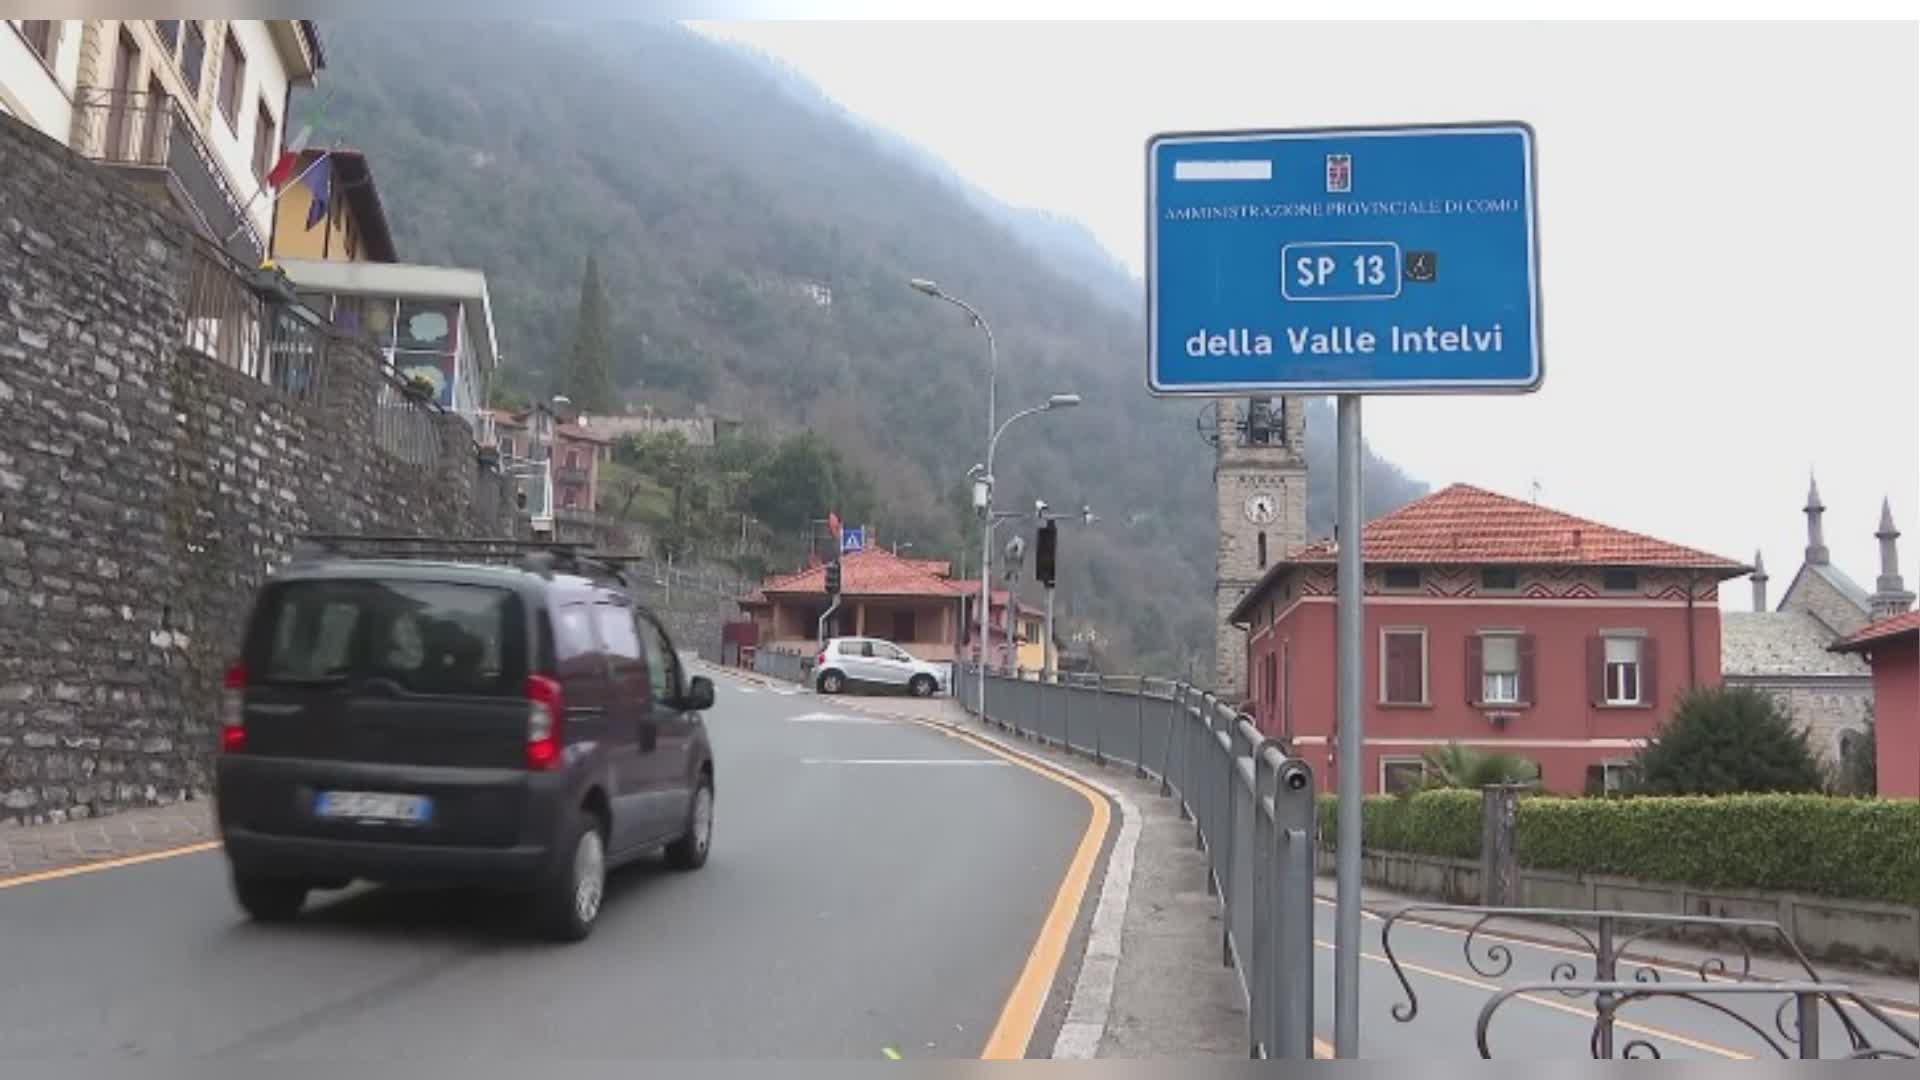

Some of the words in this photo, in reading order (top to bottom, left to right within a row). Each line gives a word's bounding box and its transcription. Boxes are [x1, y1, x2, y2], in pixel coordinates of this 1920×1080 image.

[1166, 201, 1323, 220] AMMINISTRAZIONE
[1326, 200, 1441, 216] PROVINCIALE
[1445, 200, 1463, 213] DI
[1466, 199, 1519, 212] COMO
[1297, 256, 1336, 287] SP
[1353, 255, 1386, 286] 13
[1186, 328, 1273, 357] della
[1287, 326, 1376, 354] Valle
[1392, 323, 1503, 352] Intelvi
